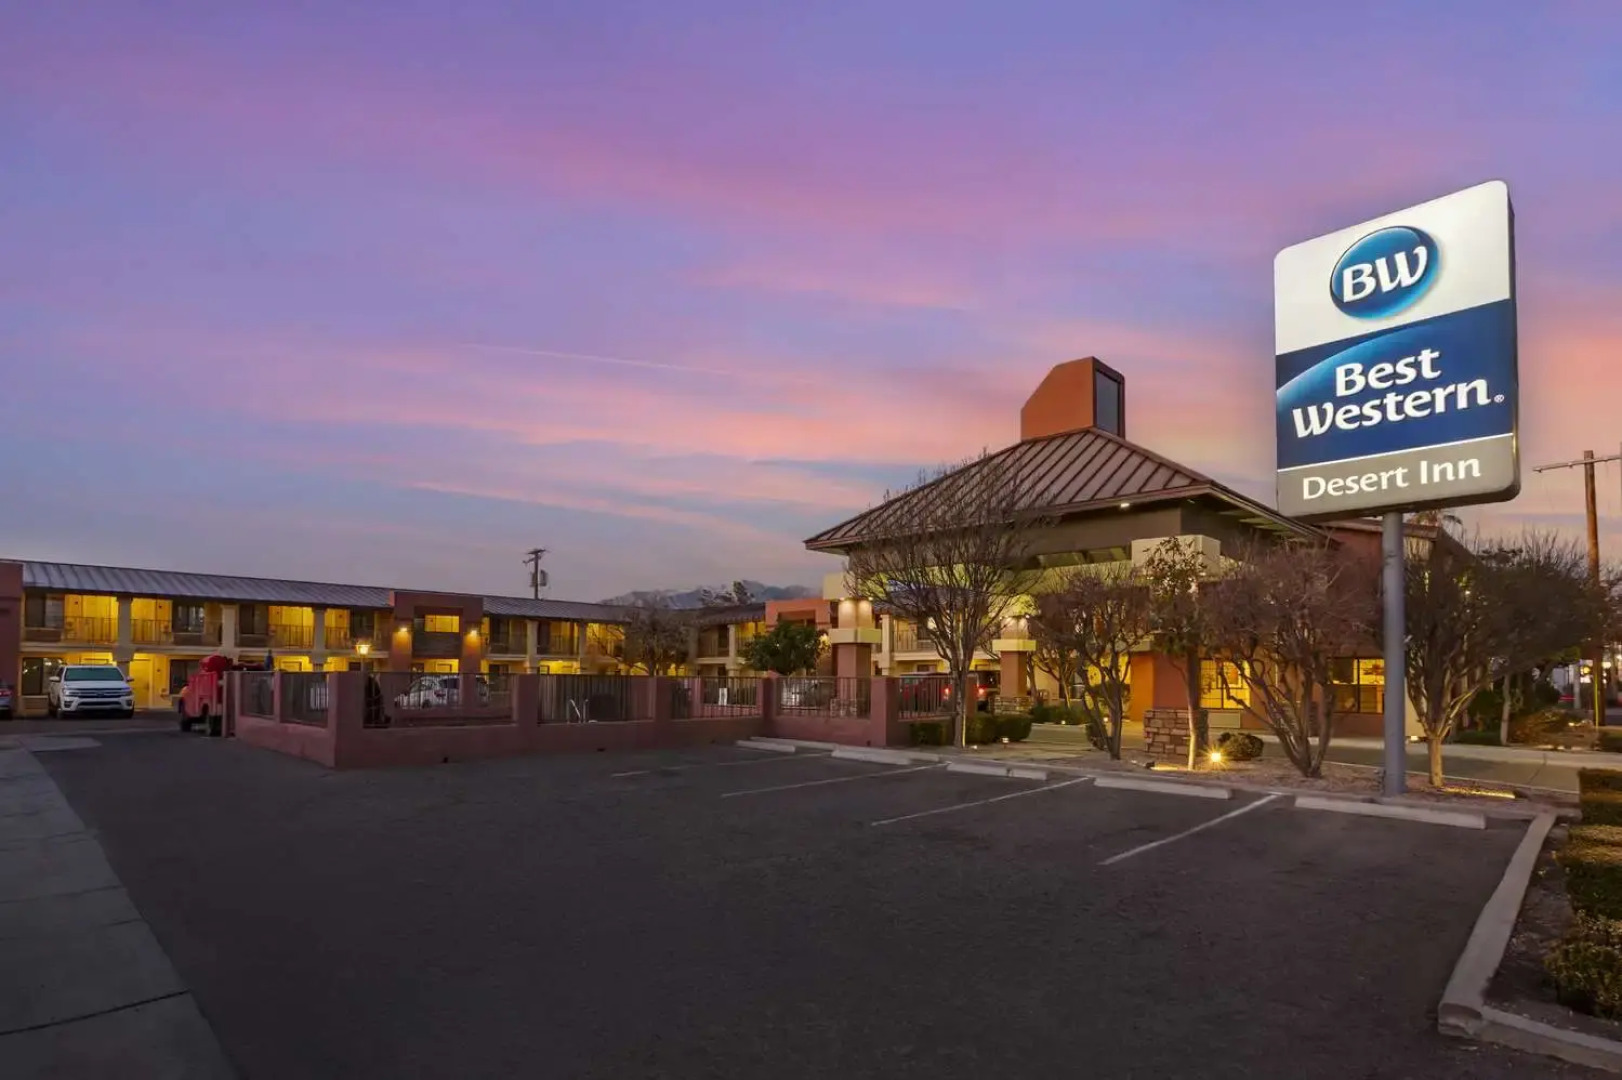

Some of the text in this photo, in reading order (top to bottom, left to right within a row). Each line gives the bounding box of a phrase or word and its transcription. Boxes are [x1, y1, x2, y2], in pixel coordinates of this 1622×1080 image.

[1342, 245, 1429, 303] BW
[1334, 348, 1442, 398] Best
[1302, 457, 1482, 500] Desert Inn
